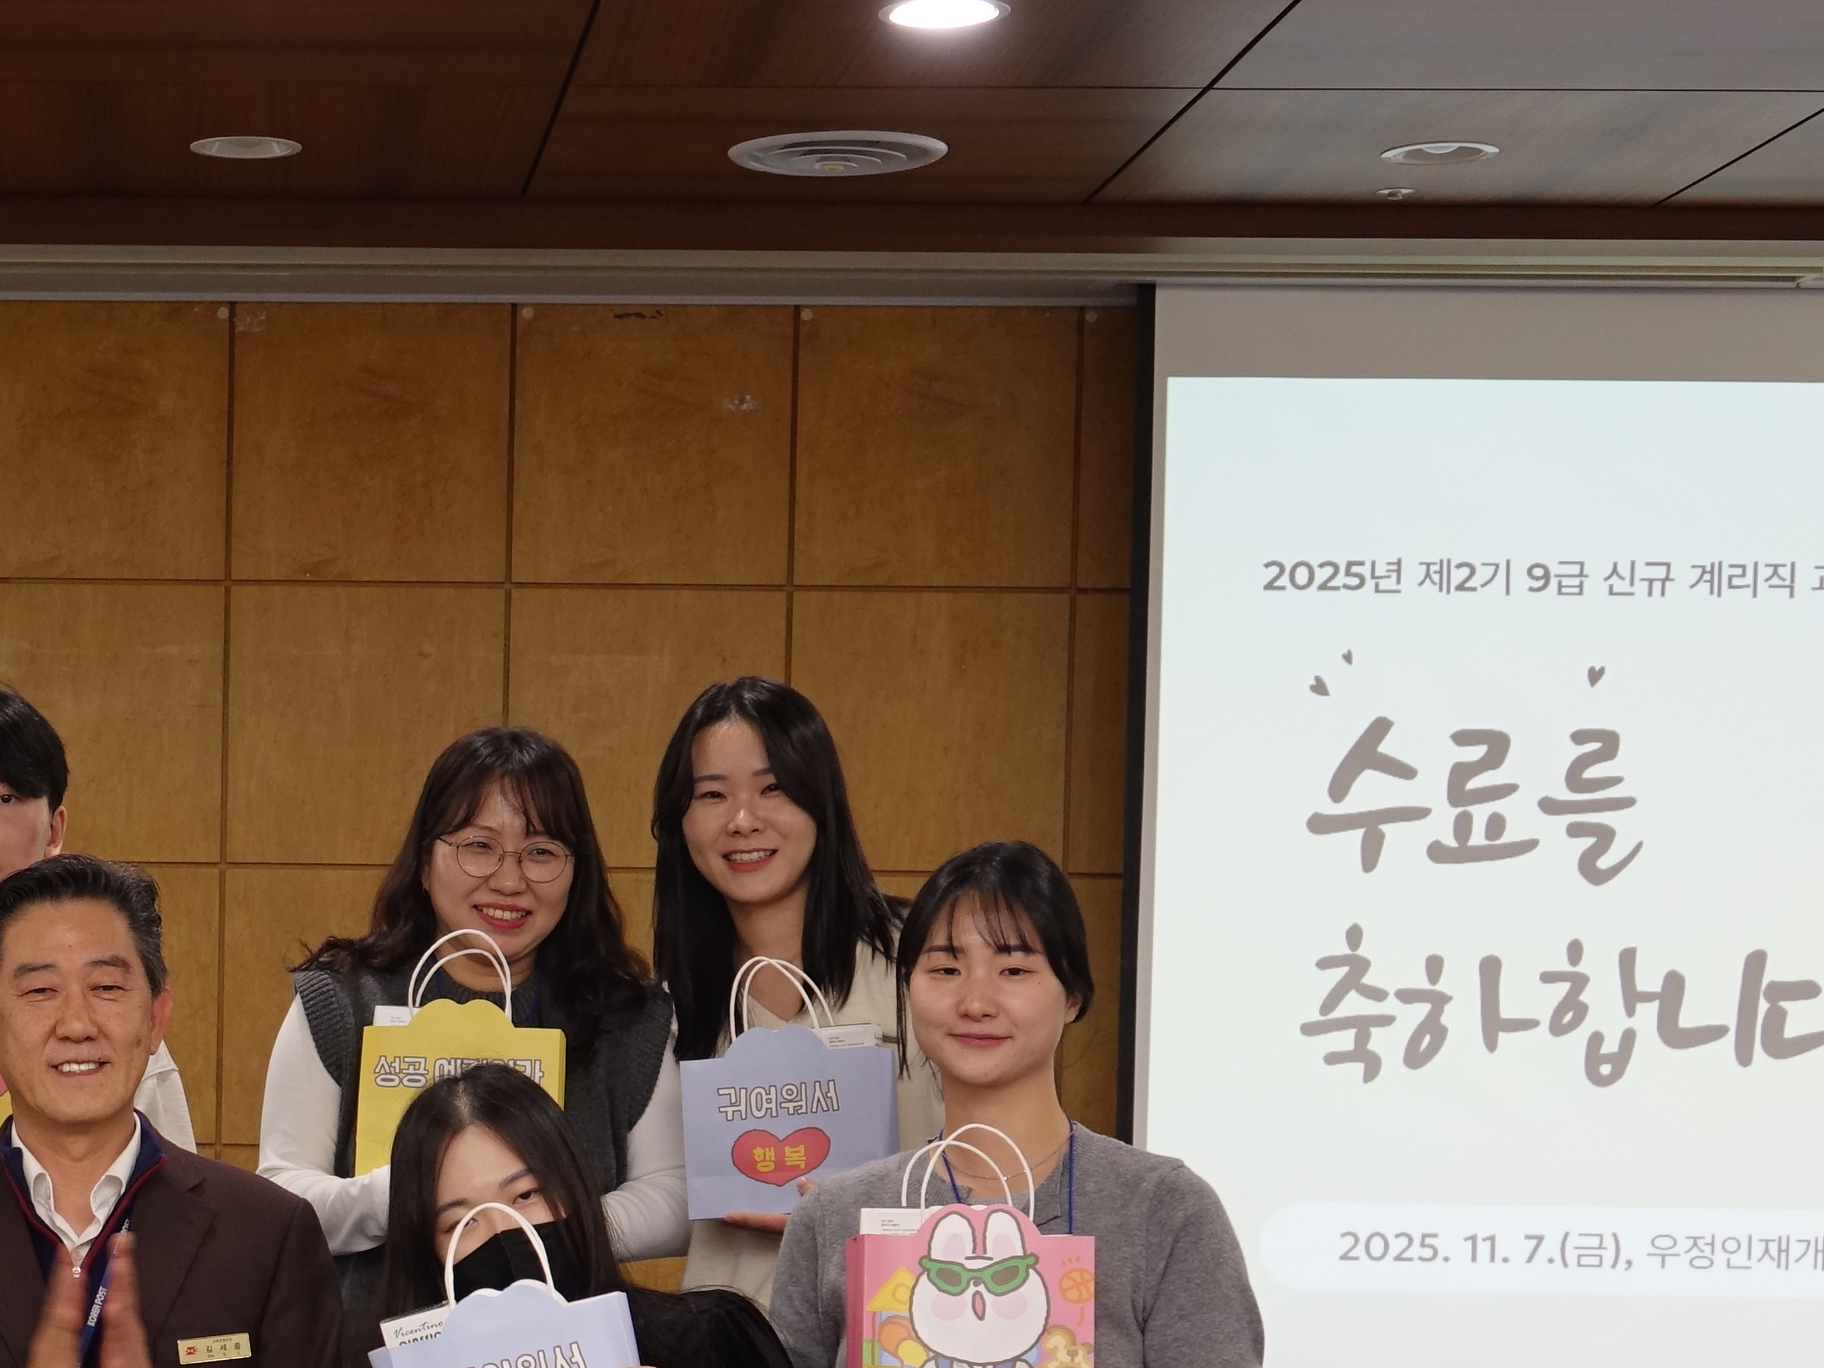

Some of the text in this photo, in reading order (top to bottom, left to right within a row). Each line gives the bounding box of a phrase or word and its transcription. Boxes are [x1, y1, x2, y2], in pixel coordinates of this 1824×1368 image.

[1262, 557, 1403, 594] 2025년
[1417, 557, 1511, 597] 제2기
[1525, 560, 1590, 597] 9급
[1602, 559, 1676, 598] 신규
[1688, 560, 1797, 600] 계리직
[1305, 714, 1644, 887] 수료를
[373, 1055, 429, 1088] 성공
[717, 1079, 840, 1122] 귀여워서
[753, 1144, 807, 1173] 행복
[1338, 1230, 1451, 1263] 2025.
[1462, 1232, 1511, 1264] 11.
[1524, 1231, 1634, 1271] 7.(금),
[95, 1285, 107, 1305] POST
